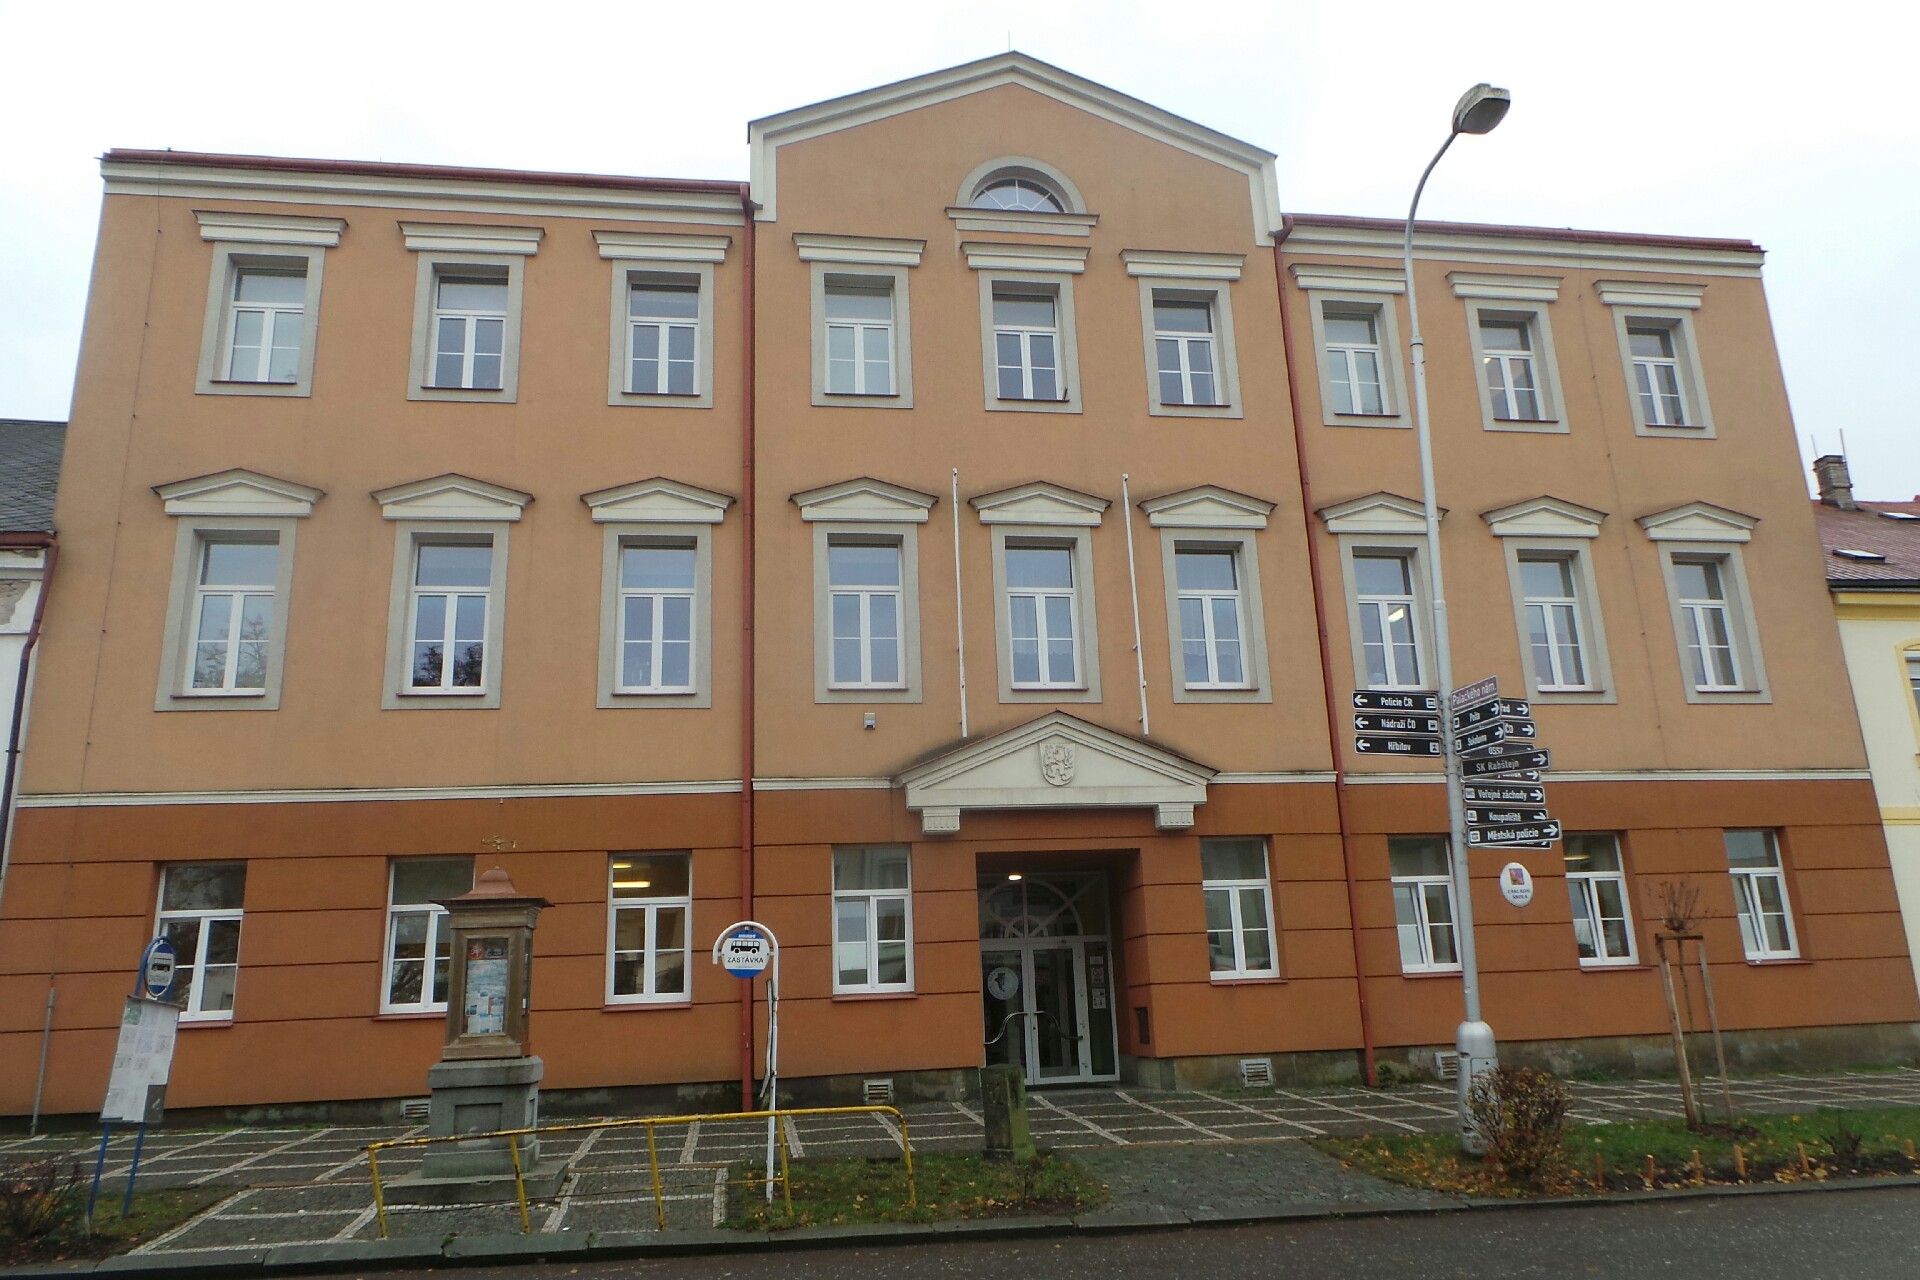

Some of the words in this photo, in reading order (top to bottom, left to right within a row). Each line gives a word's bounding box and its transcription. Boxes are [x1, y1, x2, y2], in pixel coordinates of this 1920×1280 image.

[1452, 687, 1480, 705] Palackého
[1481, 681, 1497, 695] nám.
[1380, 697, 1402, 706] Policie
[1403, 696, 1413, 707] ČR
[1381, 718, 1406, 728] Nádraží
[1388, 741, 1411, 750] Hřbitov
[1476, 762, 1485, 773] SK
[1488, 758, 1519, 771] Rabštejn
[1478, 789, 1500, 800] Veřejné
[1502, 789, 1527, 801] záchody
[1489, 812, 1521, 823] Koupaliště
[1487, 829, 1515, 840] Městská
[1516, 828, 1539, 840] policie
